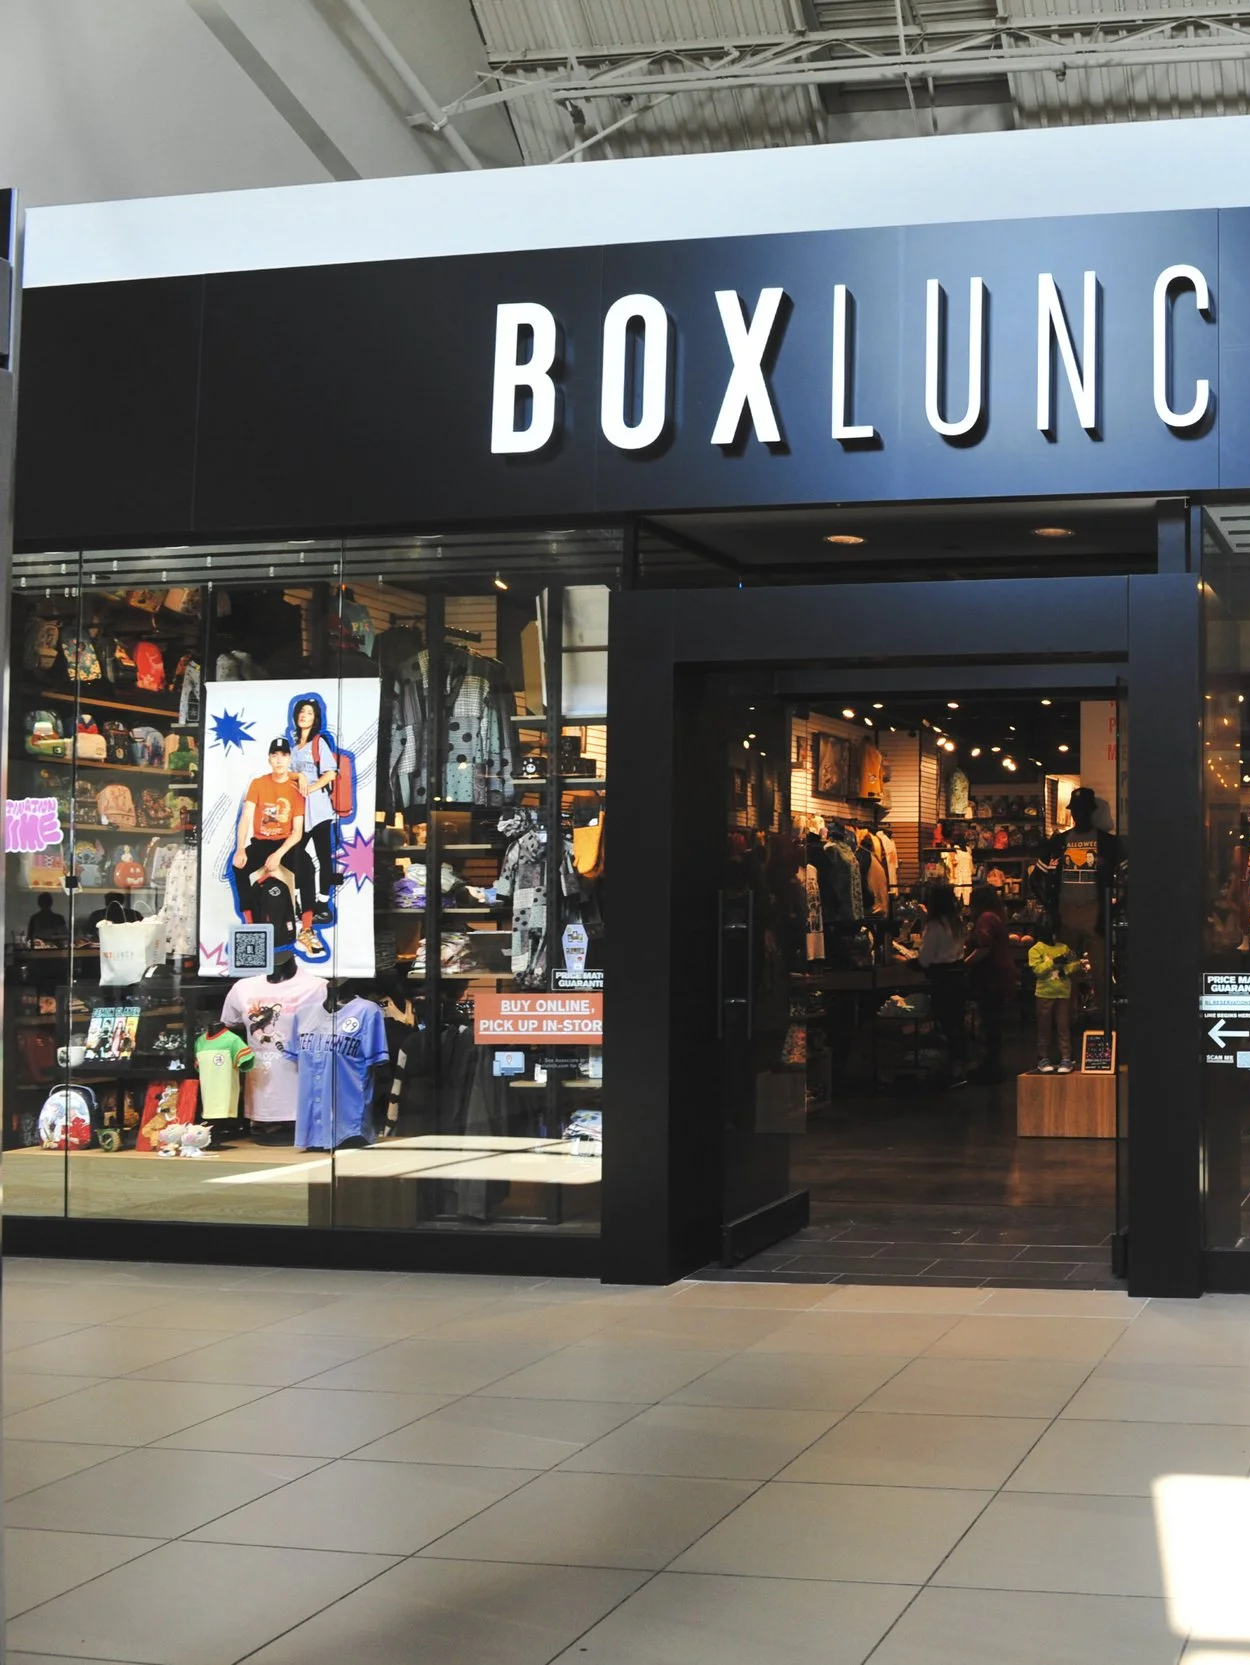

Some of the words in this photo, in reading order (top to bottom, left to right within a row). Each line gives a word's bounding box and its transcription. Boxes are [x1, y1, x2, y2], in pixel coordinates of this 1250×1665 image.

[555, 971, 582, 980] PRICE
[1207, 975, 1236, 984] PRICE
[500, 999, 531, 1012] BUY
[535, 999, 596, 1014] ONLINE,
[479, 1019, 513, 1032] PICK
[518, 1019, 538, 1032] UP
[542, 1019, 603, 1032] IN-STOR
